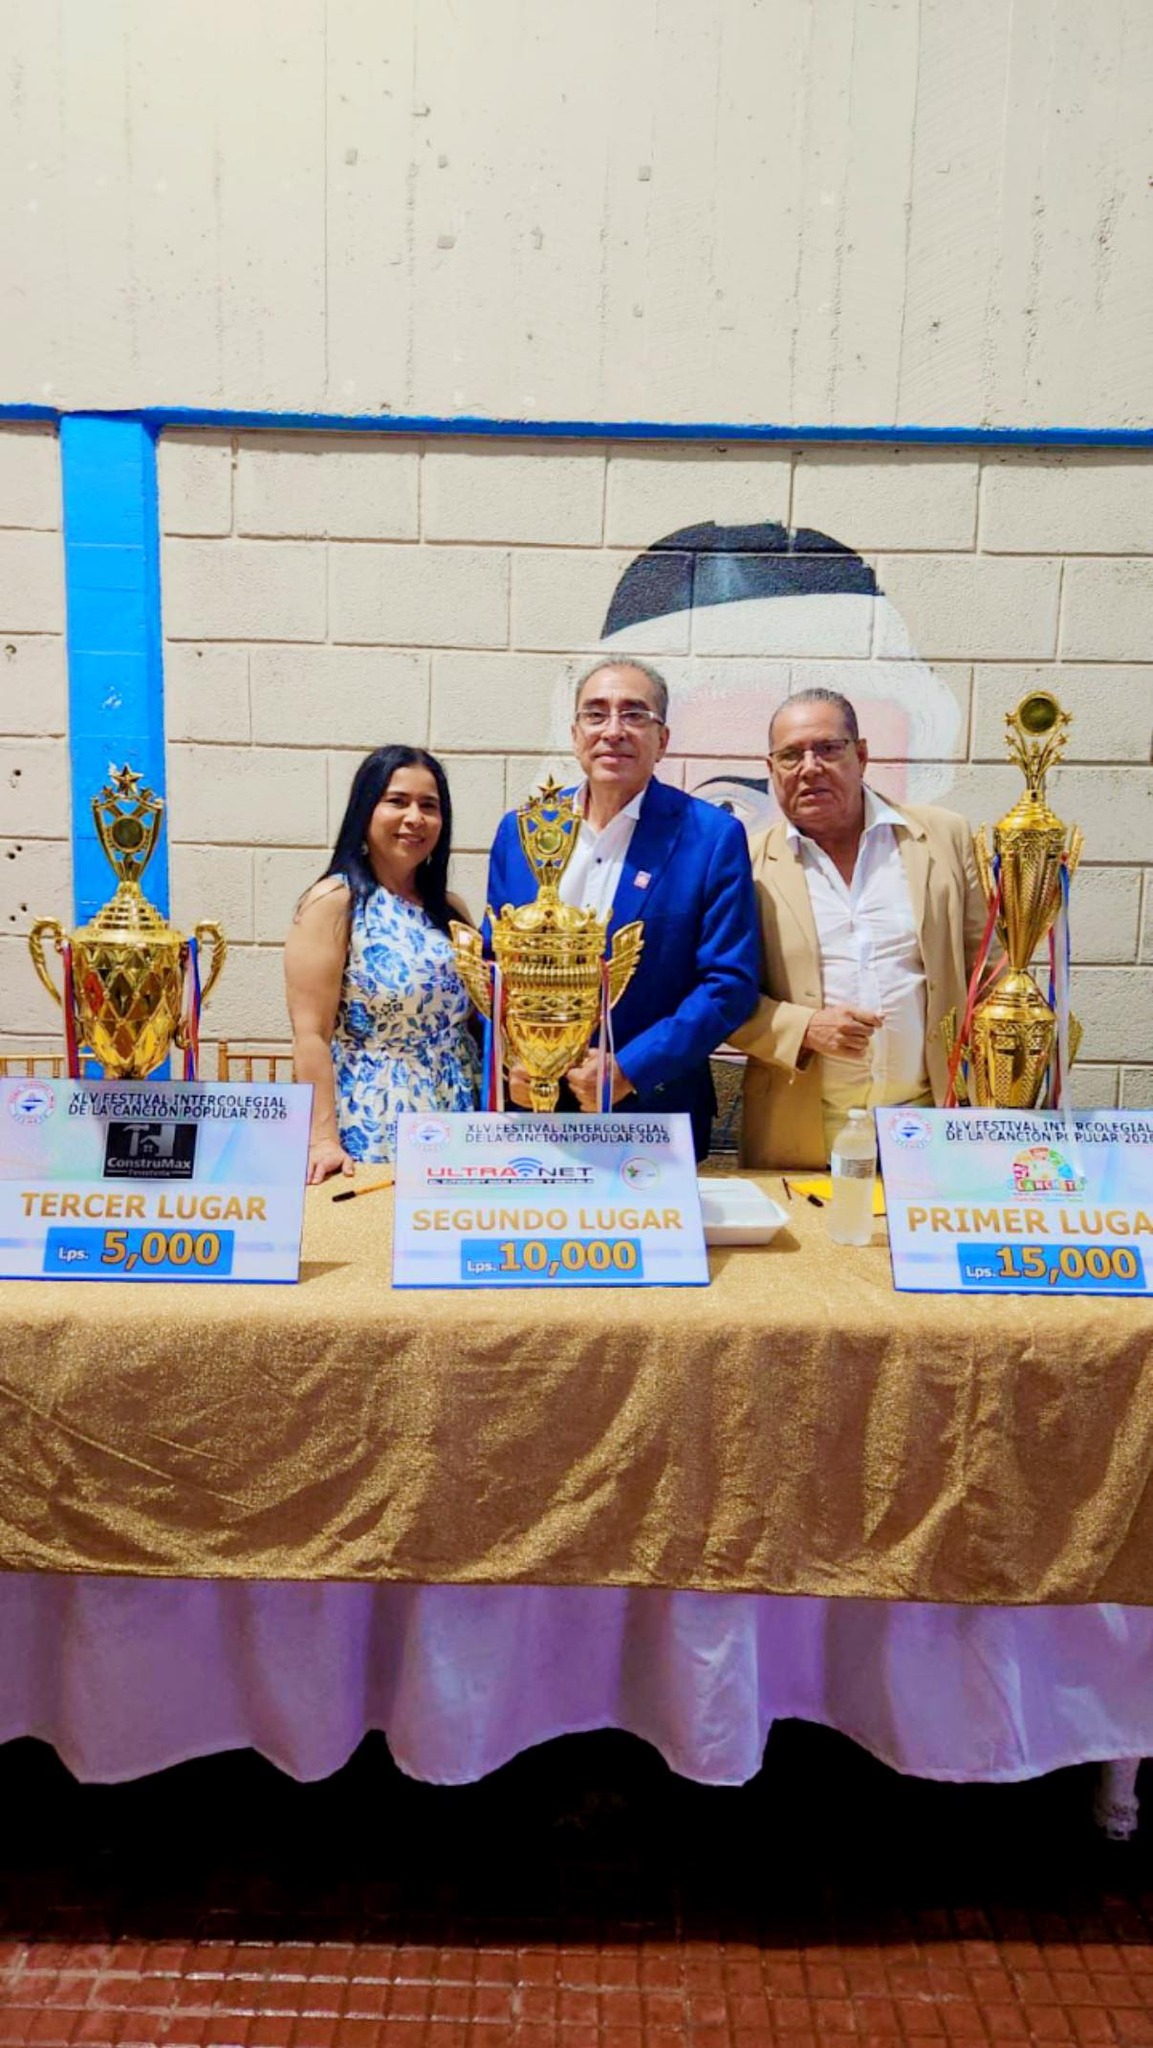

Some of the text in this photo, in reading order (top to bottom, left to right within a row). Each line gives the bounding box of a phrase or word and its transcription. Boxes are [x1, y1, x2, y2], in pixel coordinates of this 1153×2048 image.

[73, 1093, 286, 1107] XLV FESTIVAL INTERCOLEGIAL
[69, 1104, 86, 1115] DE
[92, 1105, 107, 1115] LA
[183, 1106, 248, 1118] POPULAR
[254, 1108, 287, 1119] 2026
[467, 1124, 667, 1133] XLV FESTIVAL INTERCOLEGIAL
[946, 1120, 1153, 1133] XLV FESTIVAL INTRCOLEGIAL
[466, 1133, 482, 1143] DE
[487, 1133, 502, 1143] LA
[573, 1133, 634, 1143] POPULAR
[639, 1133, 670, 1143] 2026
[946, 1130, 963, 1140] DE
[968, 1131, 983, 1141] LA
[107, 1157, 191, 1169] ConstruMax
[427, 1167, 593, 1177] ULTRA NET
[20, 1192, 267, 1221] TERCER LUGAR
[412, 1208, 683, 1231] SEGUNDO LUGAR
[907, 1206, 1050, 1234] PRIMER
[58, 1230, 222, 1272] Lps. 5,000
[467, 1240, 638, 1278] Lps. 10,000
[965, 1245, 1138, 1285] Lps. 15,000
